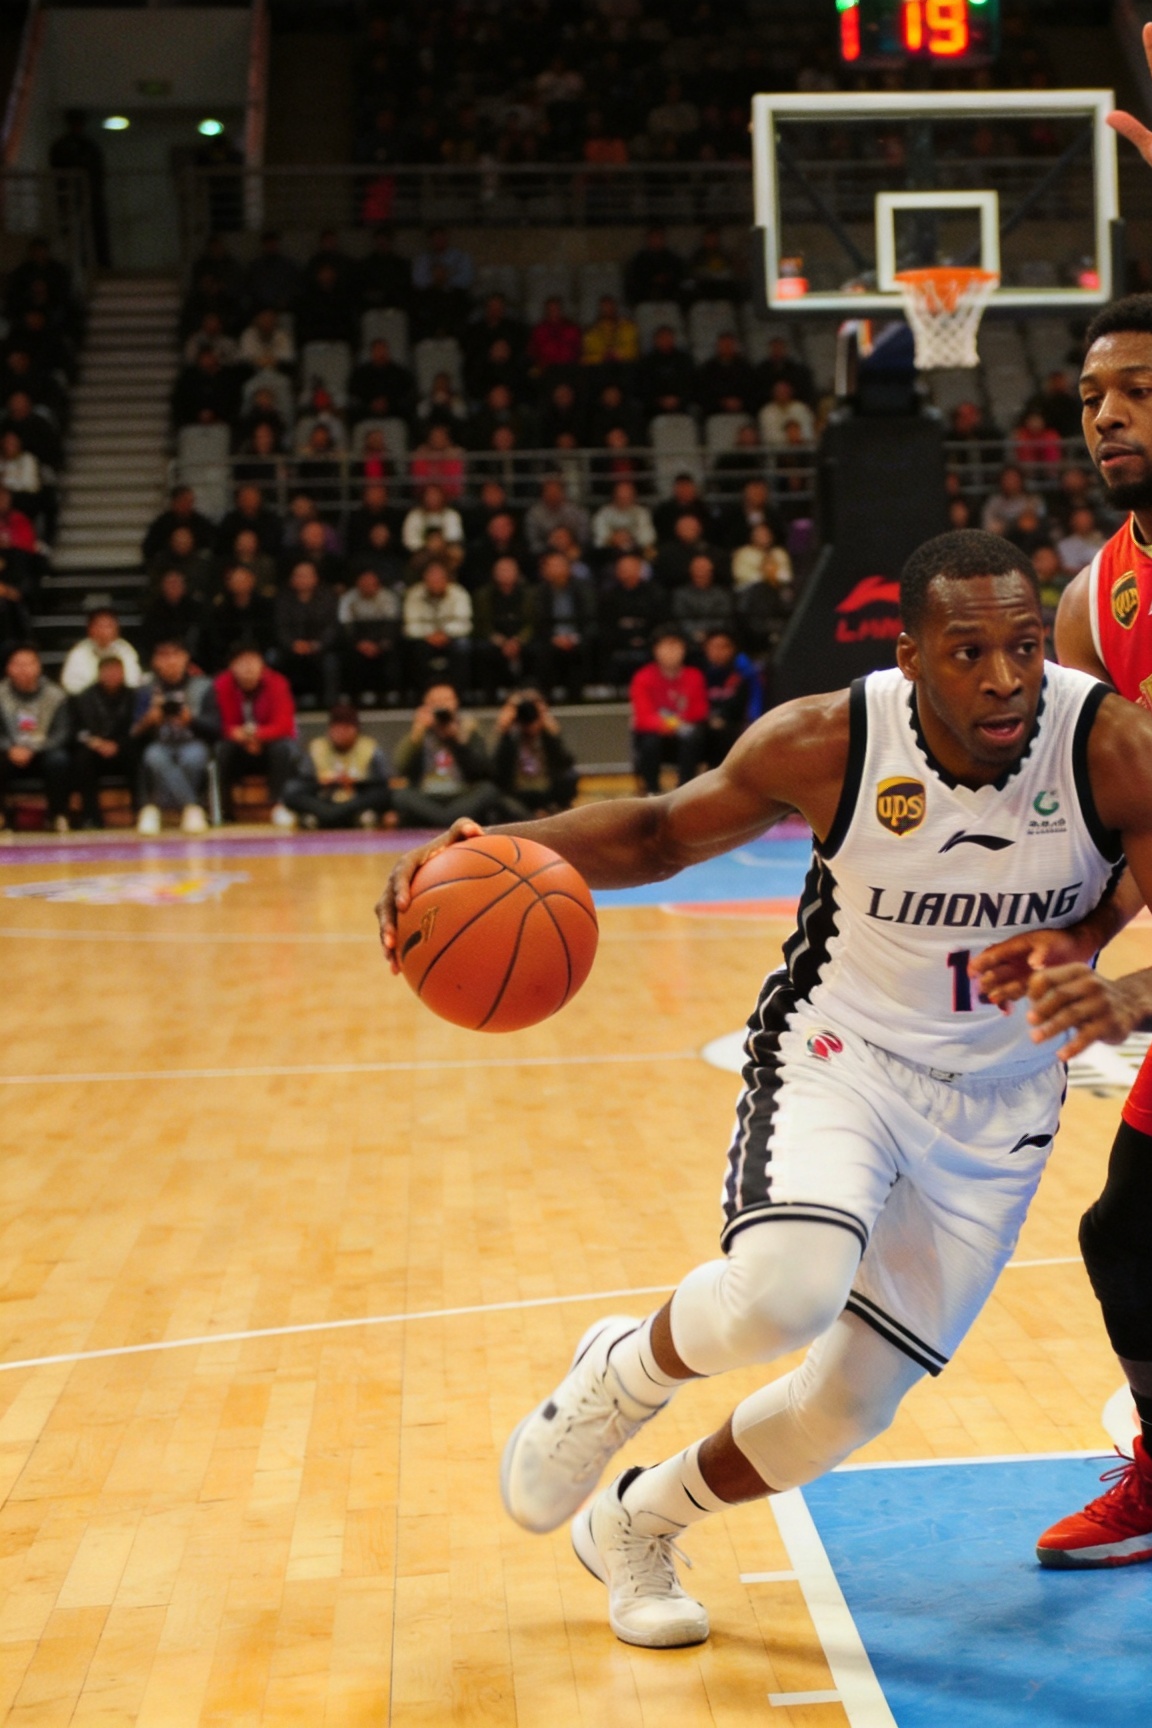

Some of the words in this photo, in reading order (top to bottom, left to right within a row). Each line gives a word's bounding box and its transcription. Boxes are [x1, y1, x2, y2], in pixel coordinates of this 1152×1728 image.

[903, 0, 968, 57] 19
[876, 794, 925, 827] ups
[865, 882, 1083, 928] LIAONING
